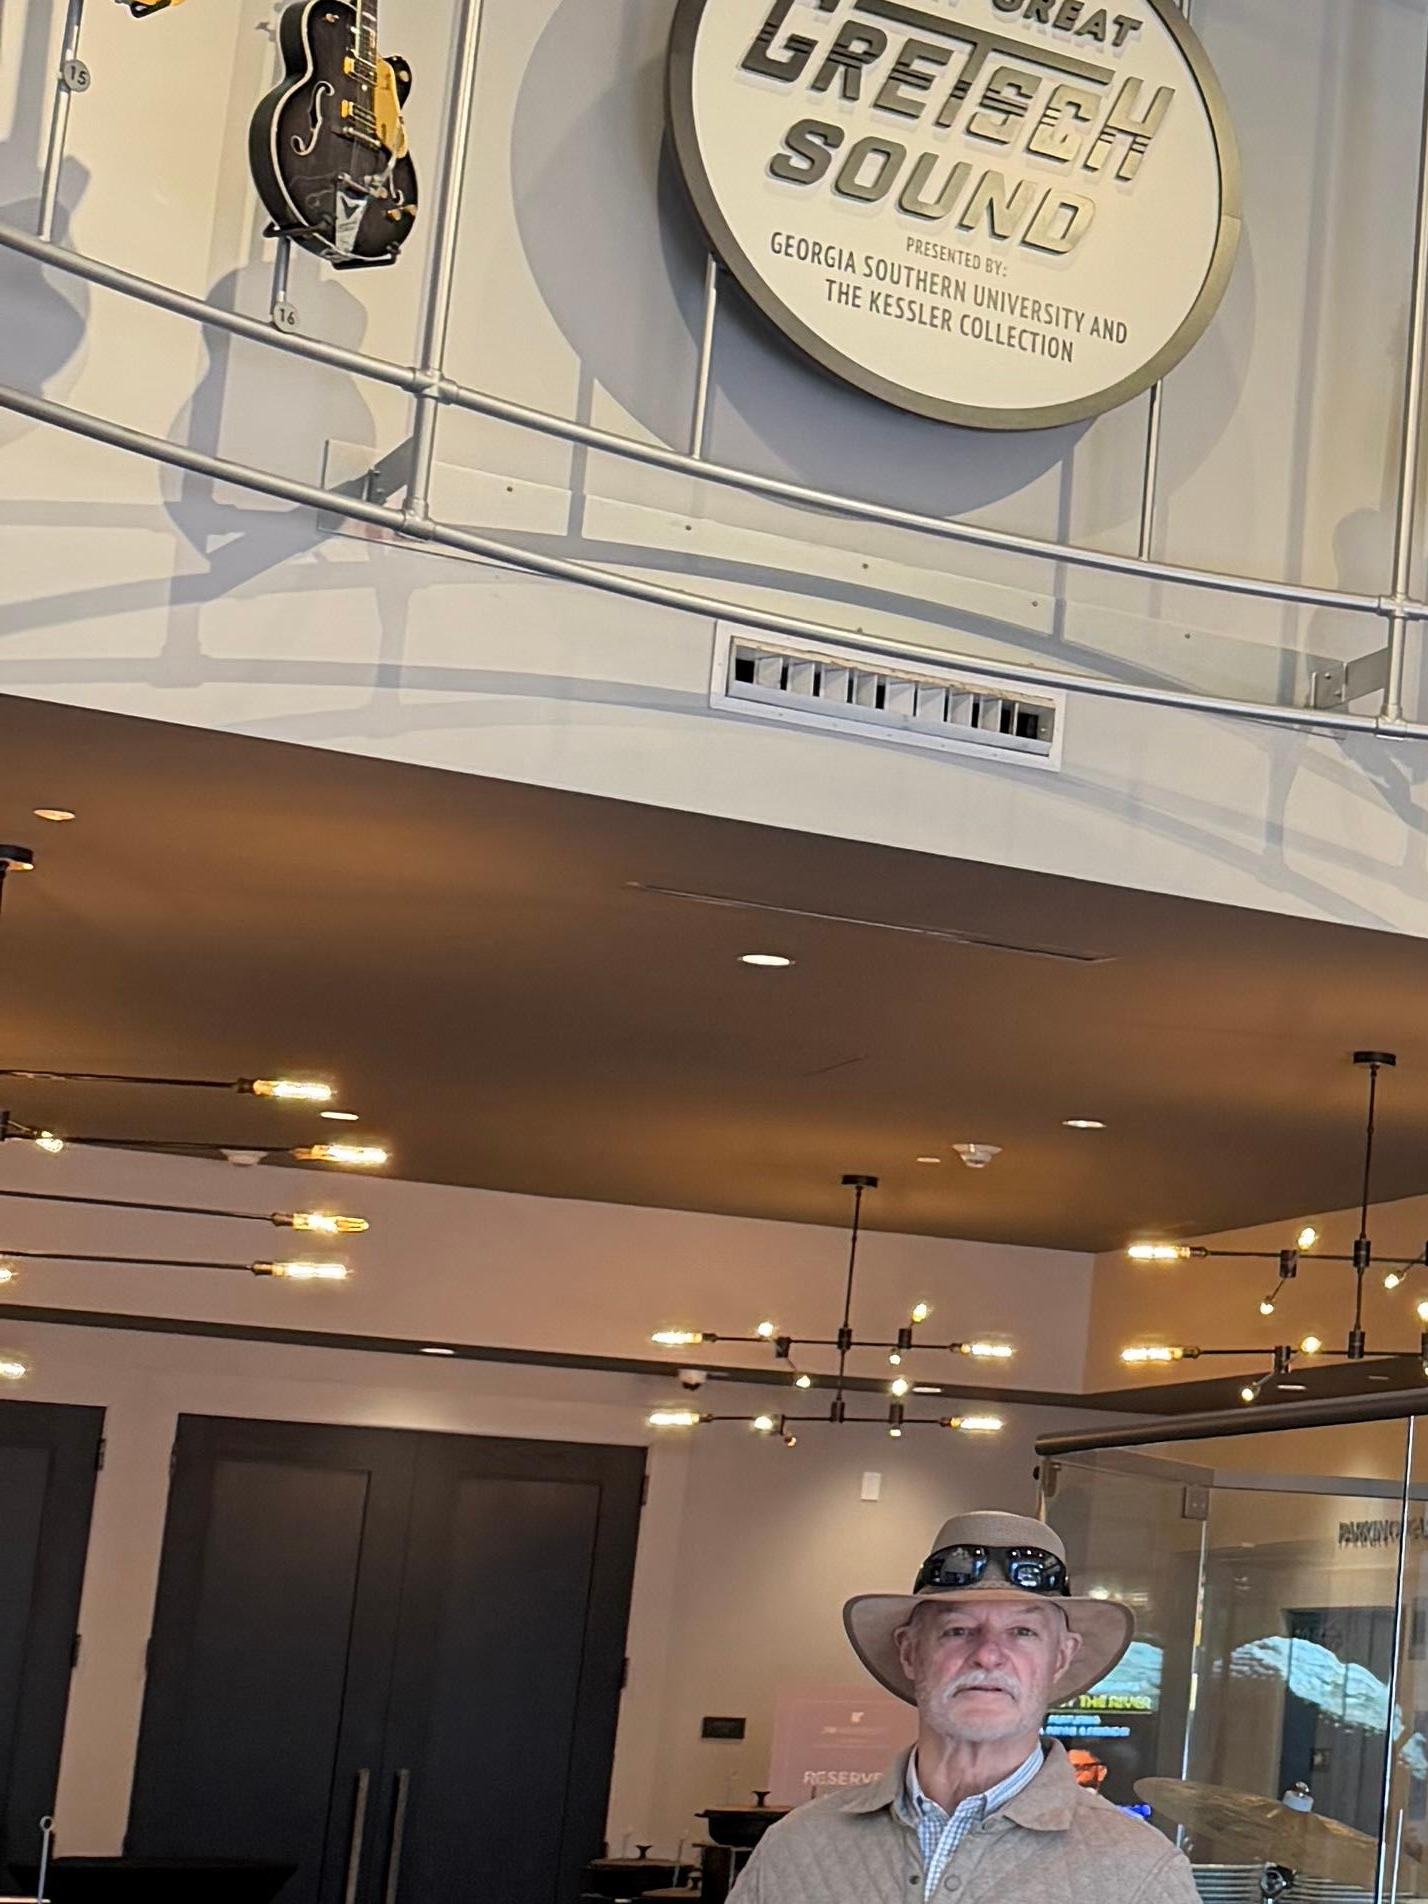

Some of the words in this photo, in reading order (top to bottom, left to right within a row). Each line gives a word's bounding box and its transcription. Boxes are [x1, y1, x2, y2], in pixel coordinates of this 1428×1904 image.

[70, 65, 87, 85] 15
[768, 118, 1096, 255] SOUND
[905, 236, 981, 271] PRESENTED
[985, 257, 1007, 278] BY:
[770, 231, 856, 274] GEORGIA
[863, 255, 967, 303] SOUTHERN
[973, 283, 1086, 334] UNIVERSITY
[1089, 315, 1128, 345] AND
[279, 308, 296, 326] 16
[825, 278, 862, 309] THE
[869, 290, 952, 332] KESSLER
[959, 314, 1074, 363] COLLECTION
[1079, 1694, 1107, 1709] THE
